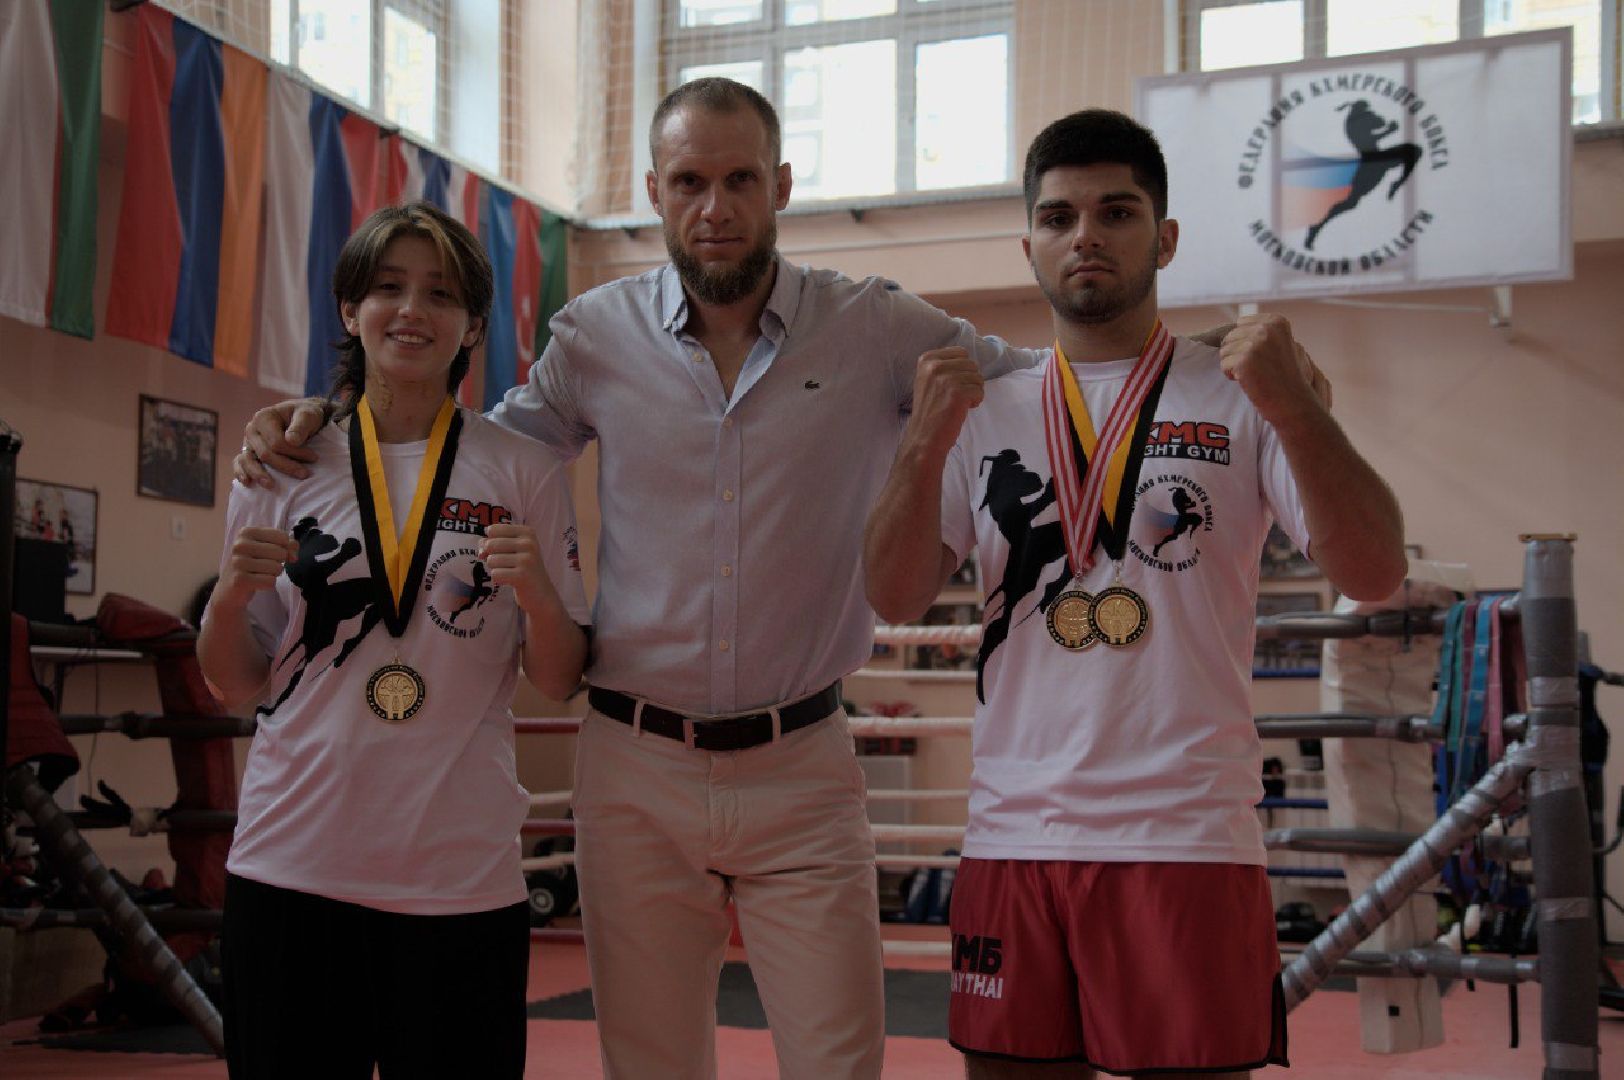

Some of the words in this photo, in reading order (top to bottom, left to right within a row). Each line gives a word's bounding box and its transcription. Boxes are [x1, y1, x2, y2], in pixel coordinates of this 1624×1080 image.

[1419, 114, 1449, 170] БОКСА
[1143, 444, 1181, 457] GHT
[1187, 445, 1229, 465] GYM
[436, 519, 478, 533] IGHT
[952, 934, 1002, 974] МБ
[950, 971, 1003, 999] AYTHAI
